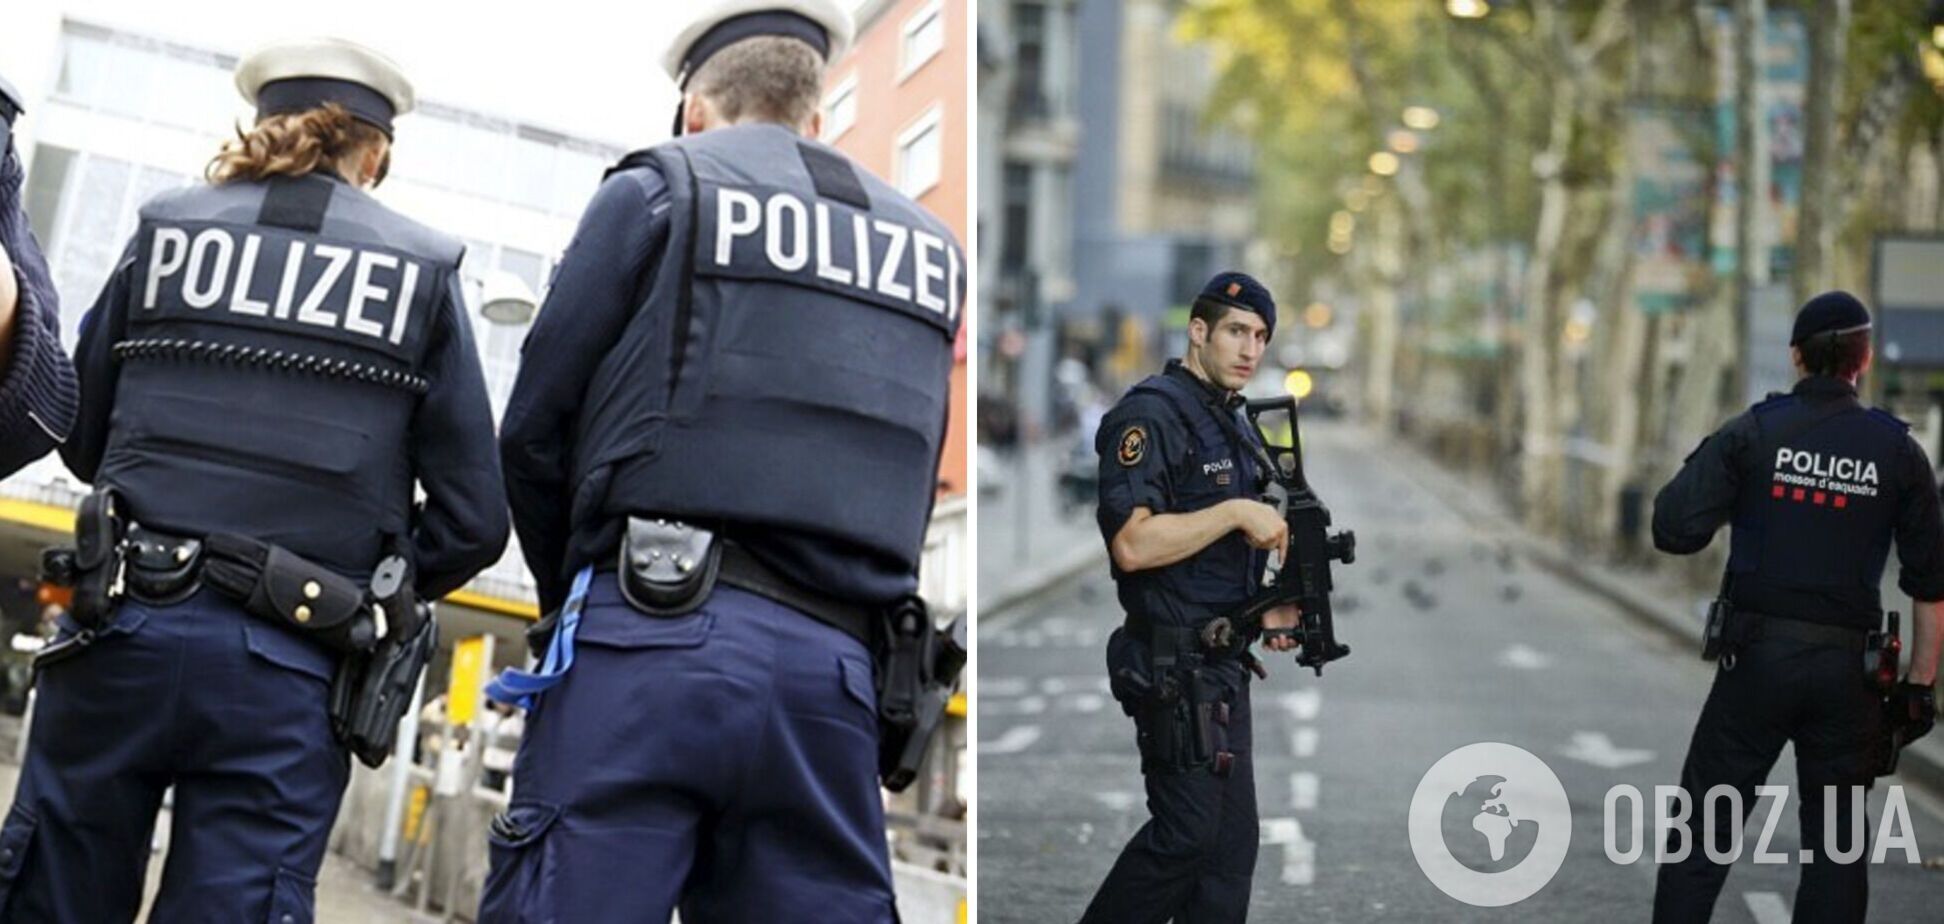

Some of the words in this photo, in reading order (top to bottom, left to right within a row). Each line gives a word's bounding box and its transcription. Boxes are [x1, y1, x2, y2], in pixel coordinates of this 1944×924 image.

[144, 227, 420, 346] POLIZEI
[714, 188, 959, 321] POLIZEI
[1773, 472, 1816, 487] mossos
[1775, 447, 1879, 484] POLICIA
